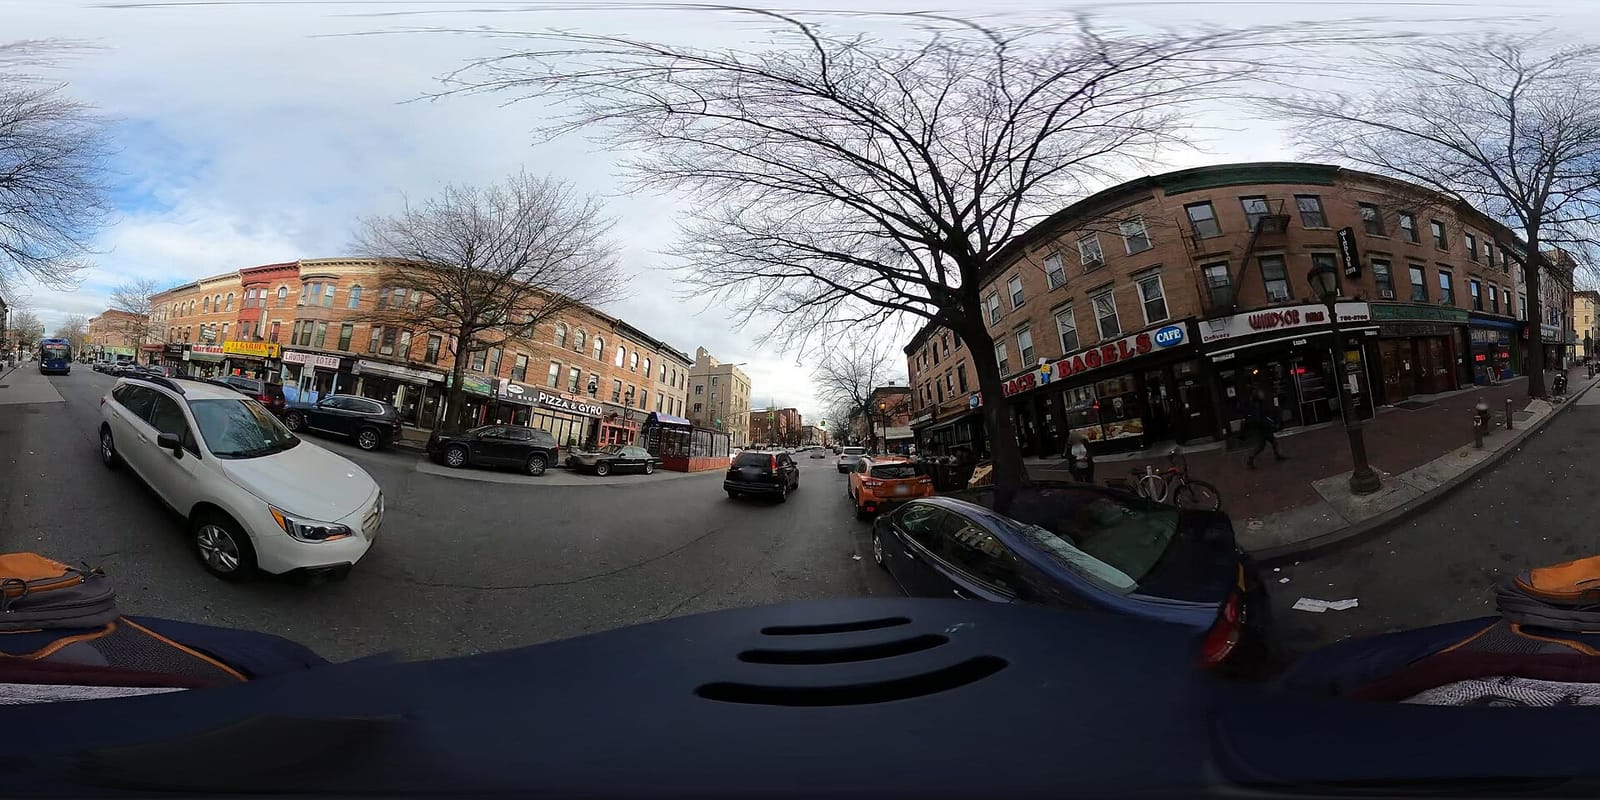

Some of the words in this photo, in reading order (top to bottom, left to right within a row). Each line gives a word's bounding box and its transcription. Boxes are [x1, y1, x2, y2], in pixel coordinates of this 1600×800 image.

[1248, 309, 1300, 331] WINDSOR
[1156, 328, 1181, 343] CAFE
[1204, 333, 1230, 342] Delivery
[1057, 333, 1153, 378] BAGELS
[539, 392, 568, 409] PIZZA
[570, 402, 577, 410] &
[578, 402, 603, 415] GYRO
